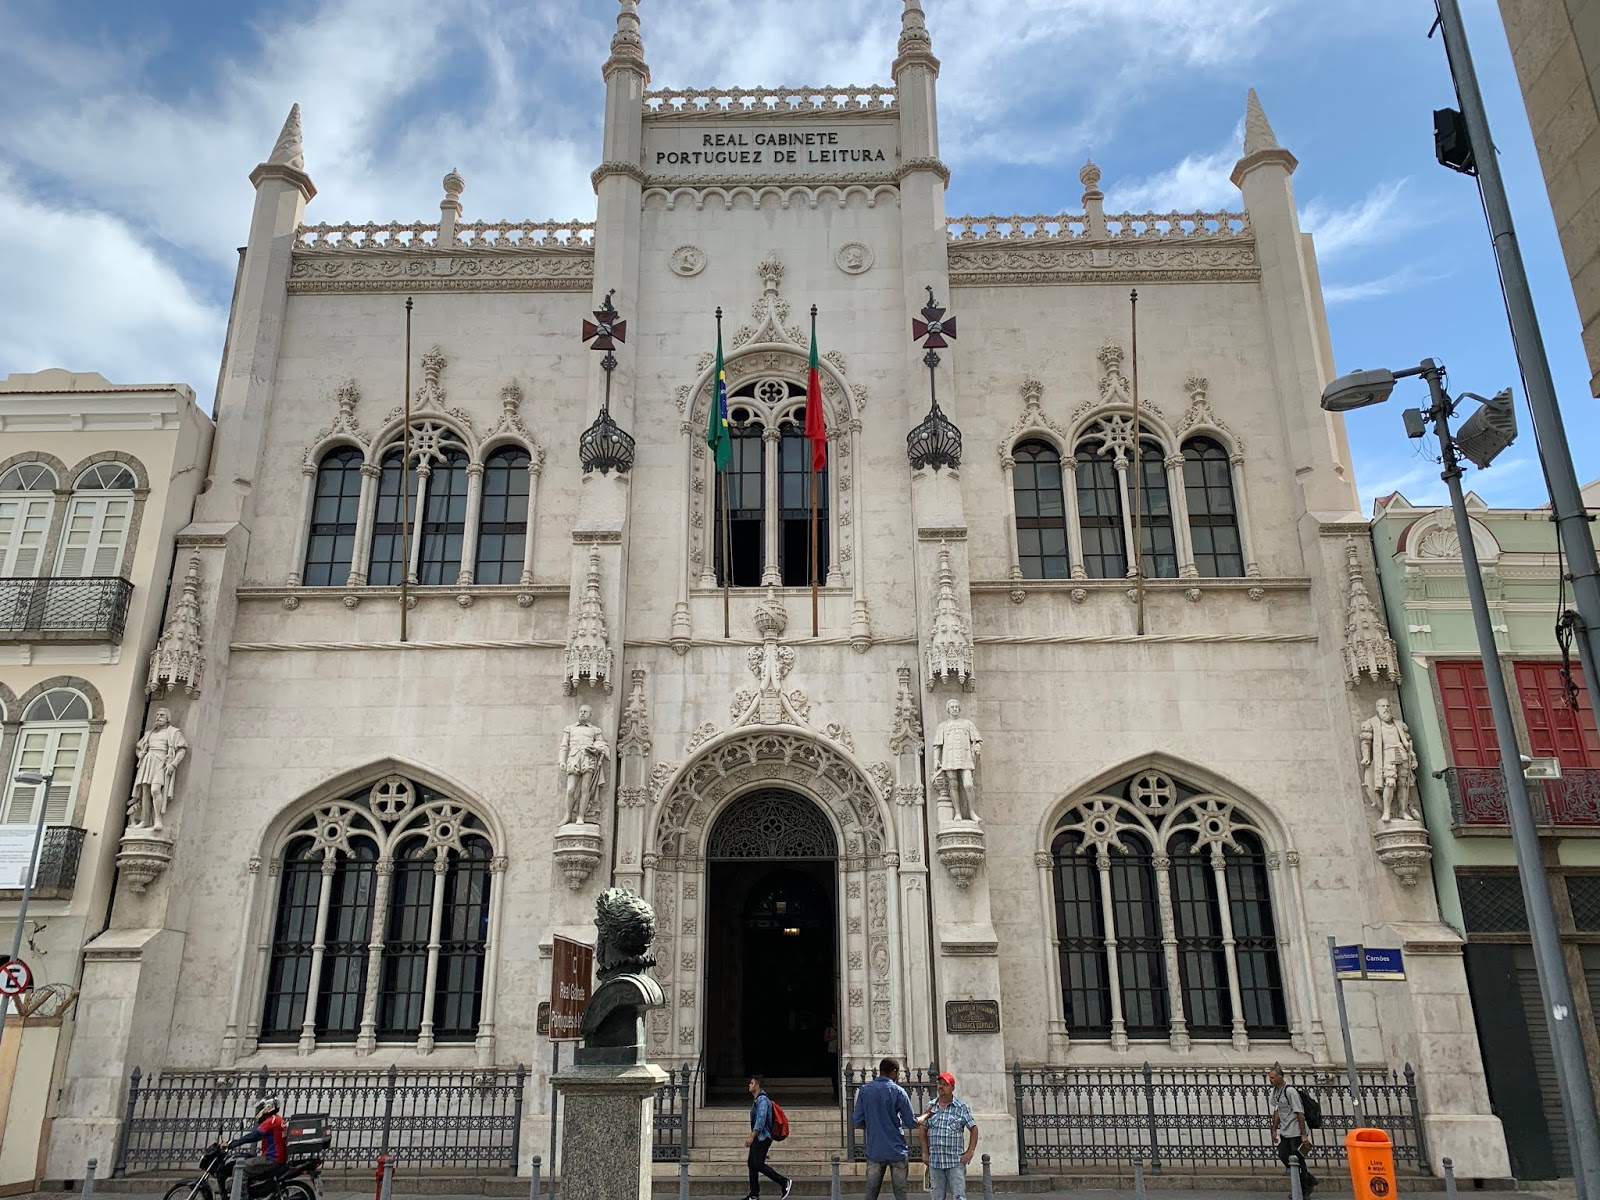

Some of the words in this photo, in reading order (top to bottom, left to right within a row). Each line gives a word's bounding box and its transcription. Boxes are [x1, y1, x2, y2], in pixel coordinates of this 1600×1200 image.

[703, 133, 748, 146] REAL
[755, 132, 838, 146] GABINETE
[656, 151, 762, 165] PORTUGUEZ
[774, 150, 797, 163] DE
[808, 149, 886, 163] LEITURA
[560, 981, 570, 999] Real
